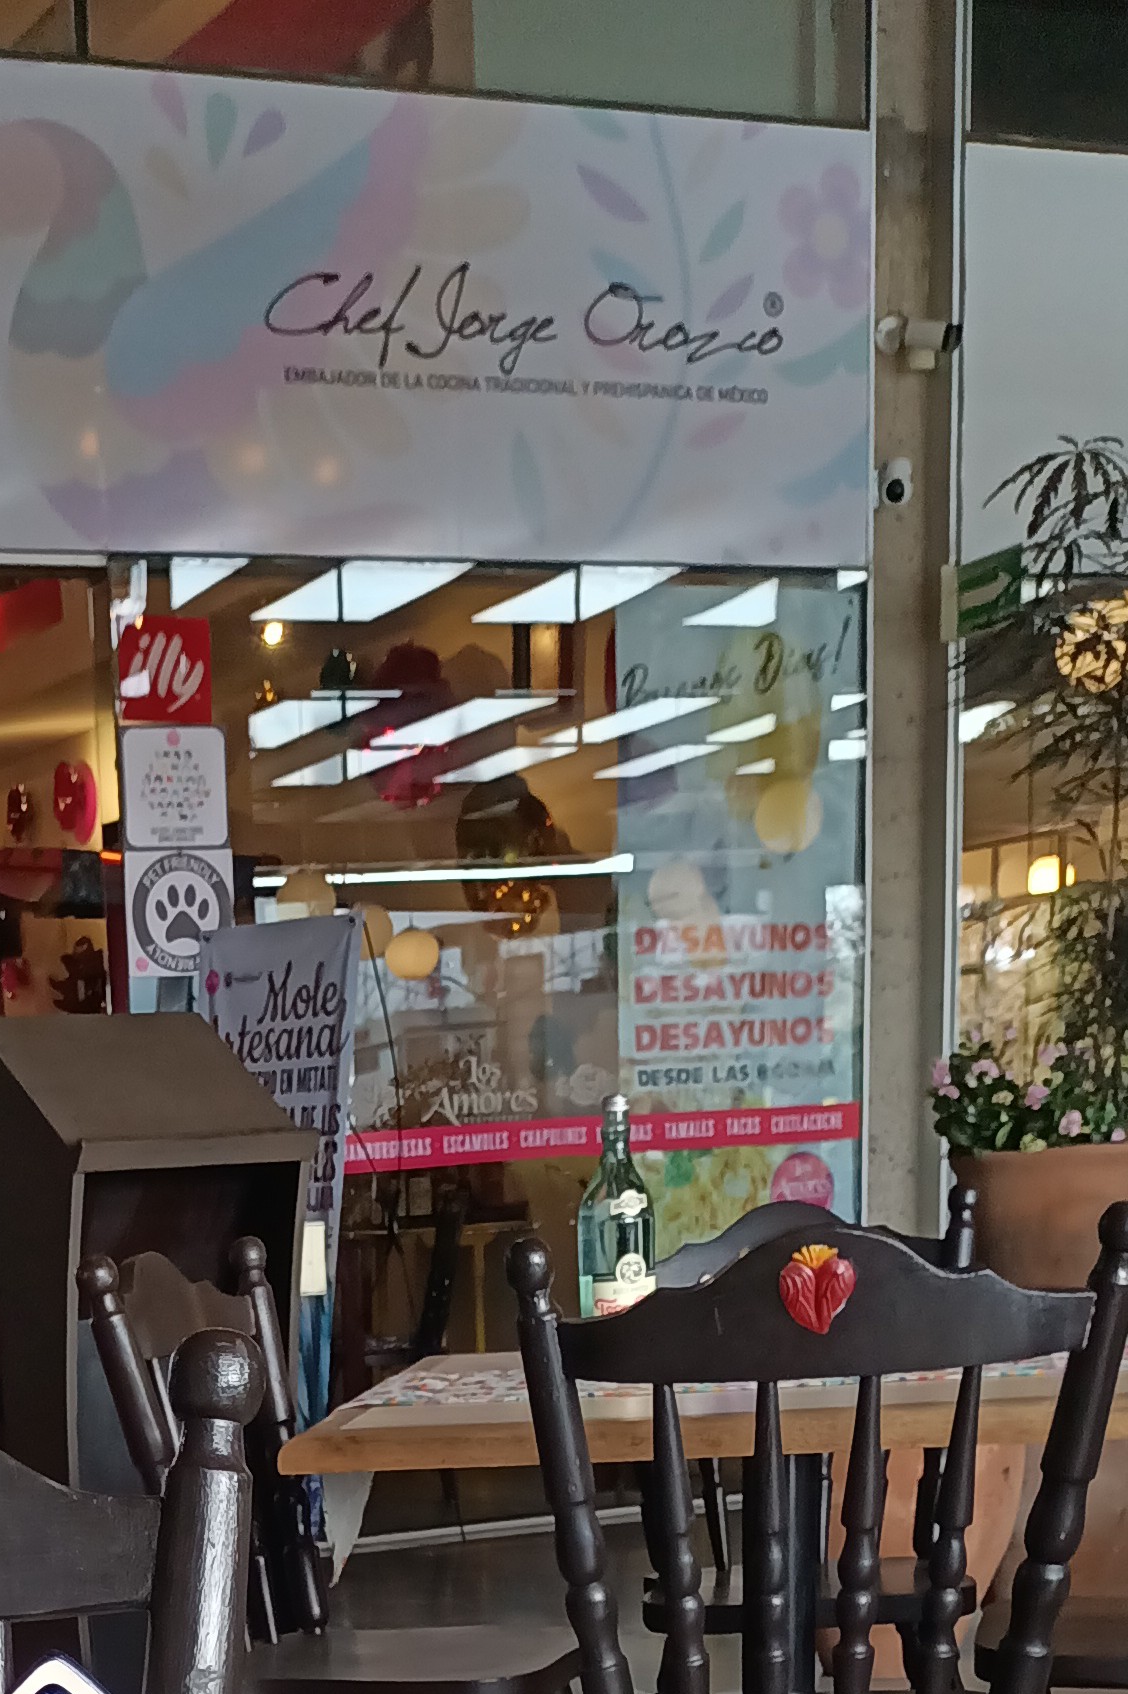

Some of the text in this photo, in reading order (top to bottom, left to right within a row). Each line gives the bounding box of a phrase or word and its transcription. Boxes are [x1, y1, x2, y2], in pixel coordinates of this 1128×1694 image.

[264, 264, 421, 369] Chef
[405, 261, 558, 375] Jorge
[128, 632, 204, 713] illy
[256, 960, 340, 1024] Mole
[634, 971, 834, 1005] DESAYUNOS
[635, 1017, 834, 1052] DESAYUNOS
[637, 1066, 703, 1087] DESDE
[712, 1063, 750, 1083] LAS
